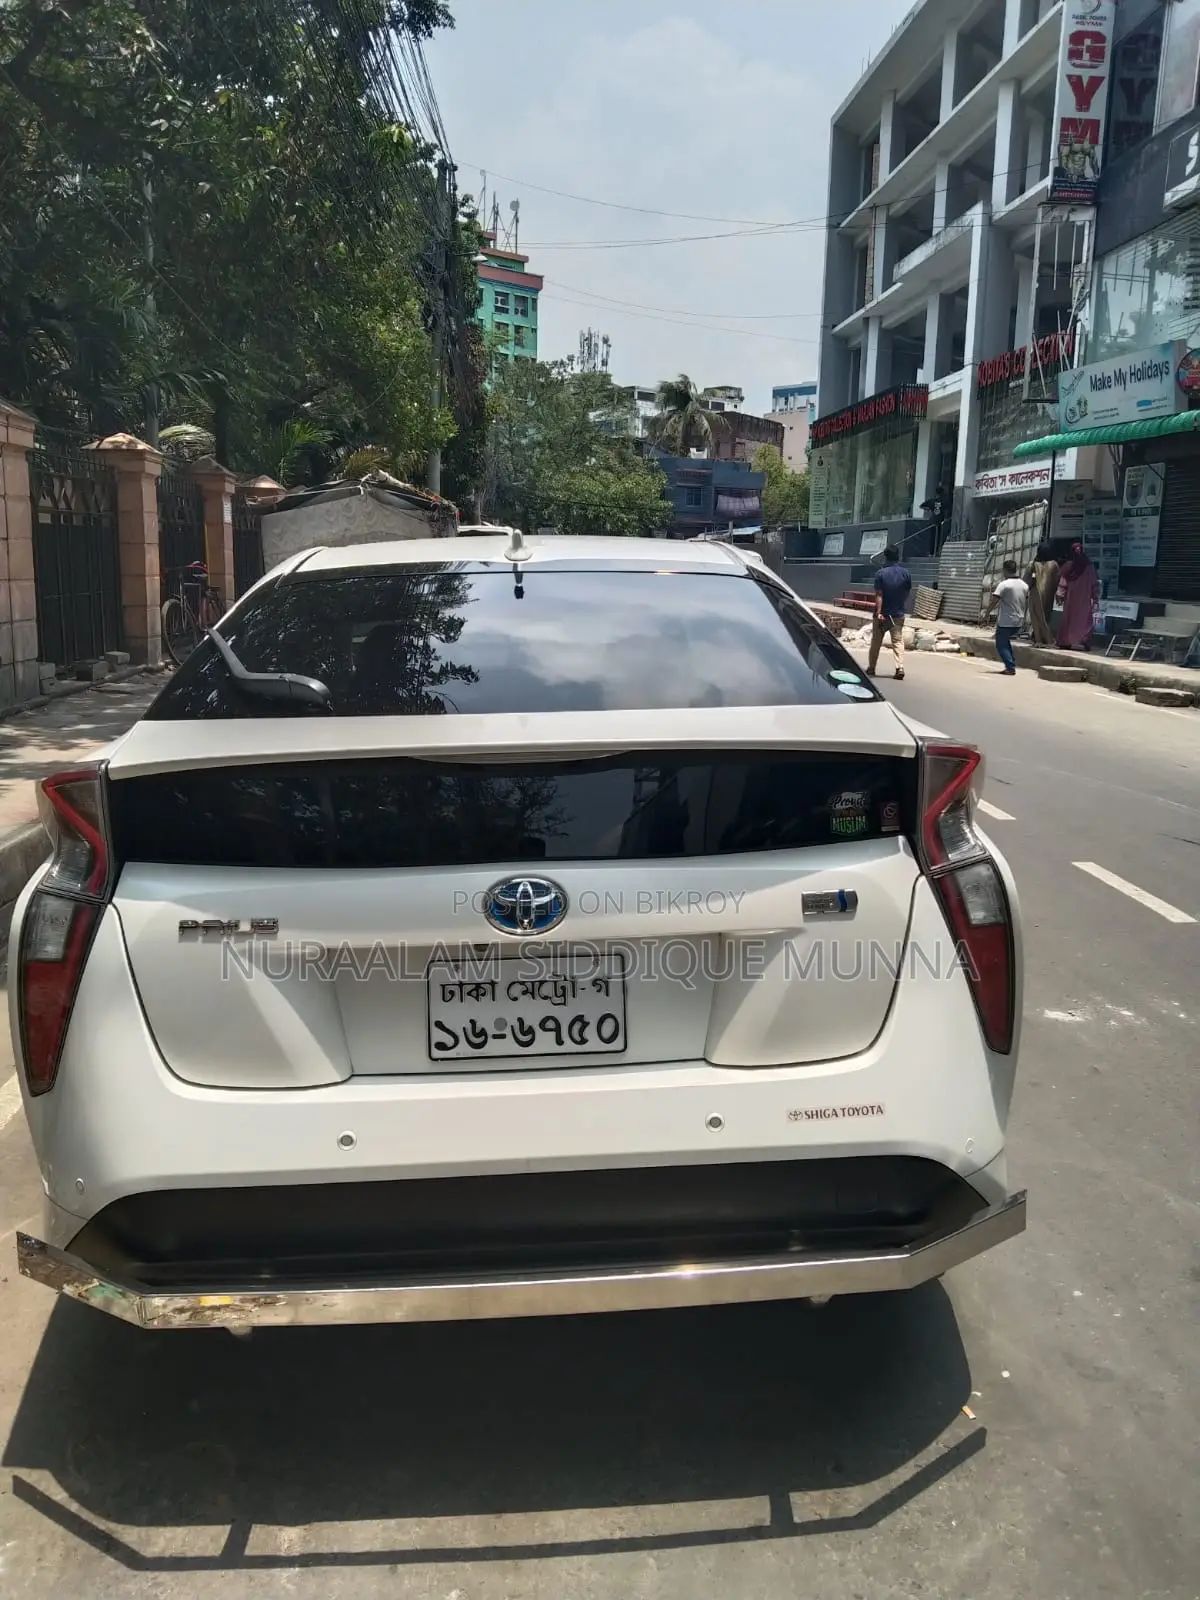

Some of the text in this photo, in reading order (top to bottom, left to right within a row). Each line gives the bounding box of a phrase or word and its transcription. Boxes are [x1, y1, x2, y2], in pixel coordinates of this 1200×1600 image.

[1059, 29, 1107, 145] GYM
[1089, 372, 1112, 392] Make
[1114, 368, 1127, 391] My
[1129, 359, 1170, 384] Holidays
[975, 473, 998, 490] কবিতা
[832, 815, 866, 833] MUSLIM
[440, 980, 498, 1003] ঢাকা
[434, 1012, 620, 1051] ১৬-৬৭৫০
[804, 1105, 884, 1119] SHIGA TOYOTA
